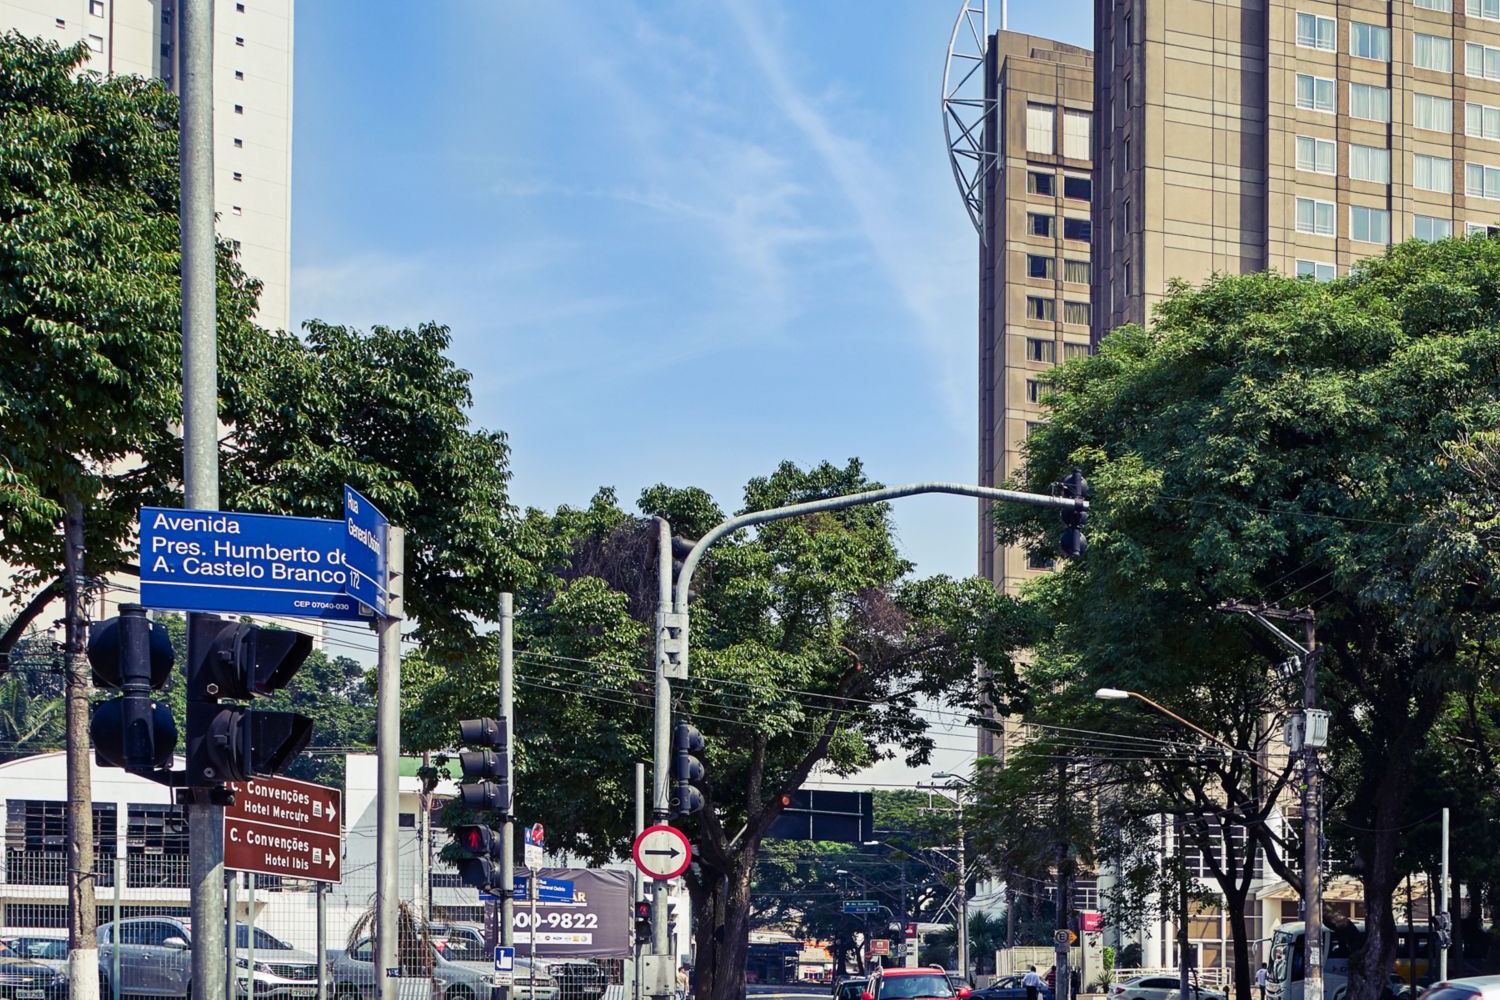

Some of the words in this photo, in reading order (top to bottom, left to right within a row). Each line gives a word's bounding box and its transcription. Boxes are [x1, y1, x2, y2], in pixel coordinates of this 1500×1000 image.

[347, 491, 359, 515] Rua
[152, 512, 241, 535] Avenida
[348, 517, 368, 546] General
[152, 536, 207, 556] Pres.
[214, 540, 321, 564] Humberto
[153, 556, 175, 574] A.
[182, 557, 265, 579] Castelo
[271, 563, 347, 585] Branco
[349, 570, 360, 590] 172
[293, 600, 311, 609] CEP
[311, 601, 350, 611] 07040-030
[246, 780, 310, 805] Convenções
[244, 800, 270, 816] Hotel
[272, 806, 310, 823] Mercure
[229, 827, 242, 843] C.
[246, 830, 310, 852] Convenções
[265, 853, 290, 867] Hotel
[292, 857, 310, 870] Ibis
